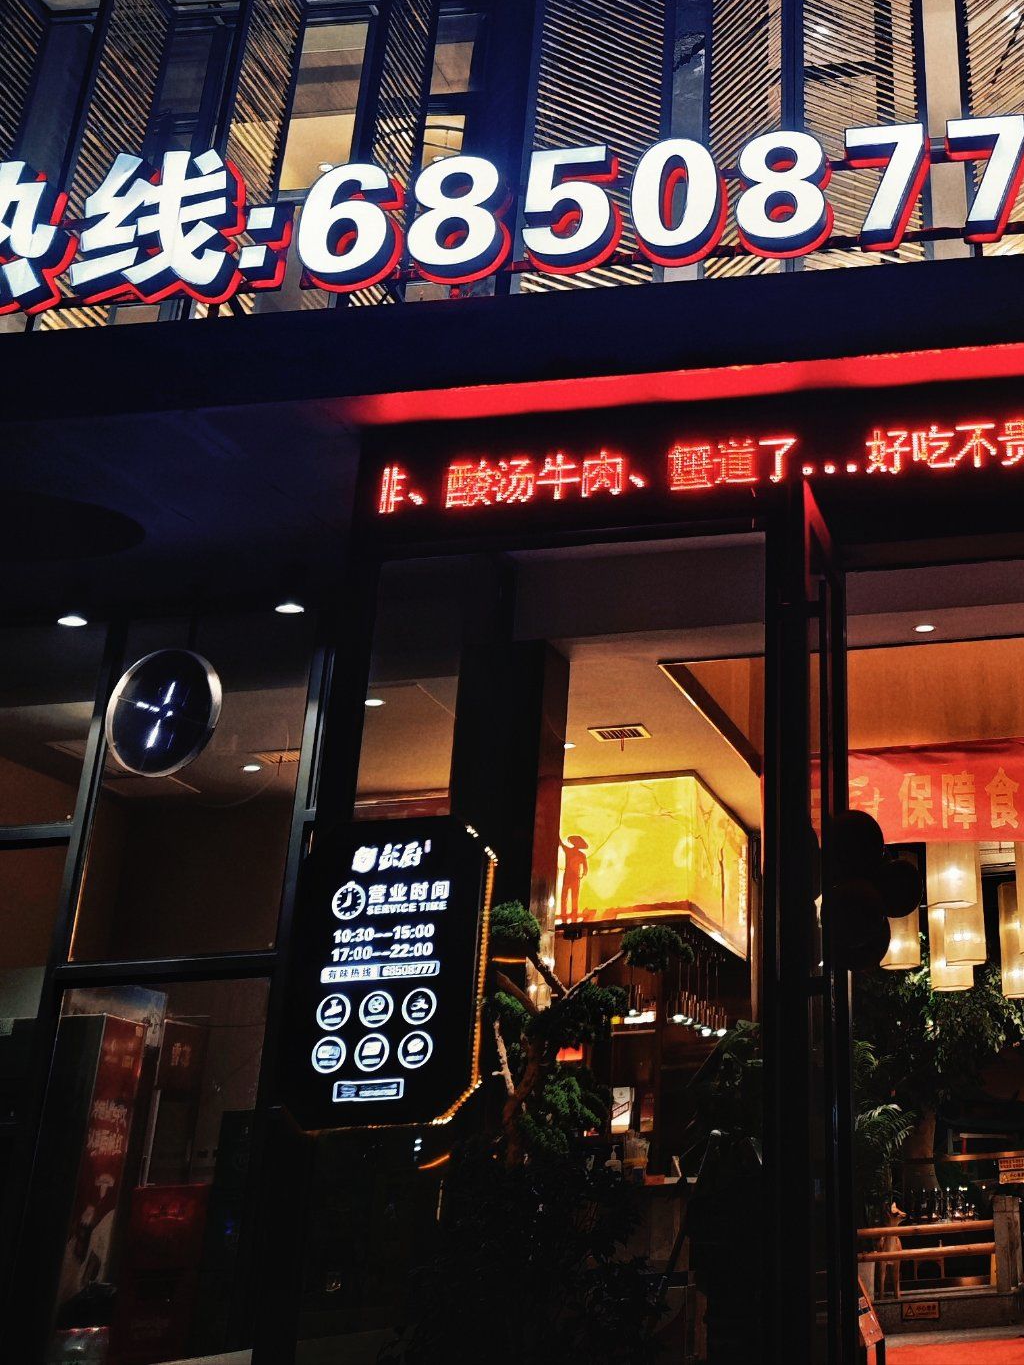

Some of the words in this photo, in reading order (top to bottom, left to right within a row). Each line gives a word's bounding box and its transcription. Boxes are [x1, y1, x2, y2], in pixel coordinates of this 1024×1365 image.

[368, 880, 451, 905] 营业时间
[366, 902, 417, 916] SERVICE
[418, 900, 448, 912] TIME
